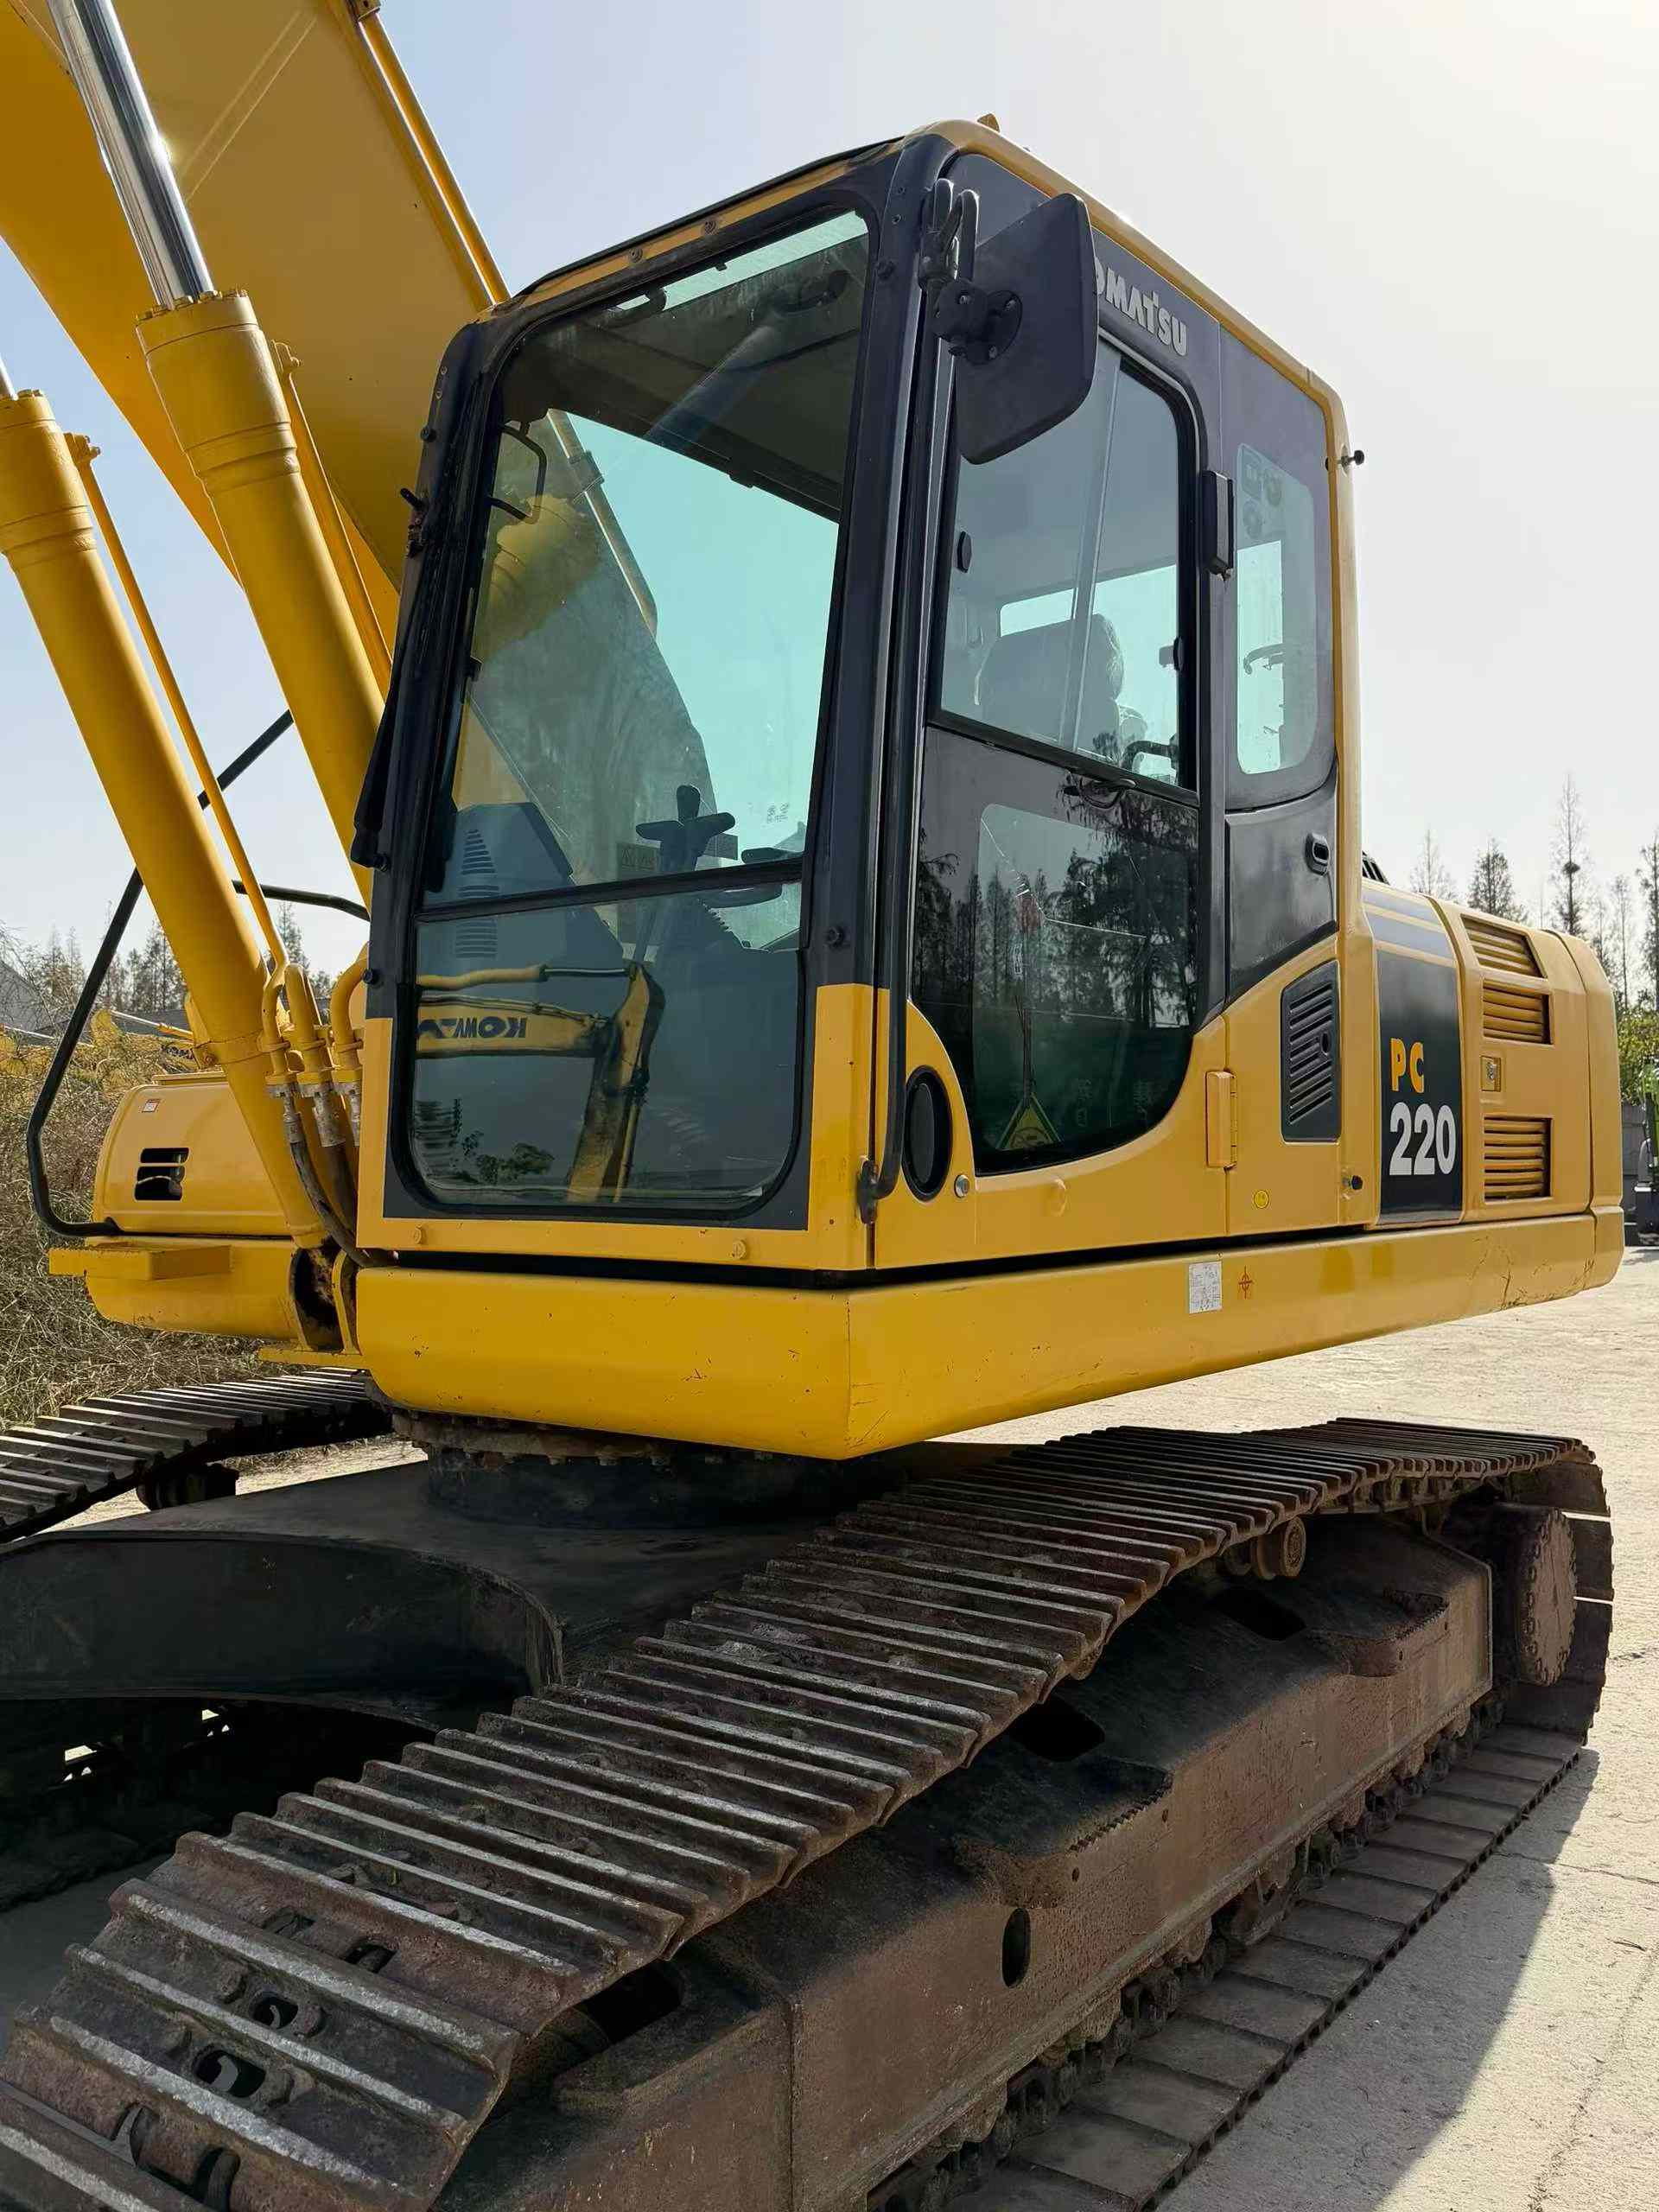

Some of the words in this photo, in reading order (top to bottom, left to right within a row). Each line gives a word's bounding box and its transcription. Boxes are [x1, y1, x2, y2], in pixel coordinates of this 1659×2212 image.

[1095, 257, 1187, 357] OMATSU
[1389, 1038, 1425, 1094] PC
[1389, 1102, 1457, 1176] 220
